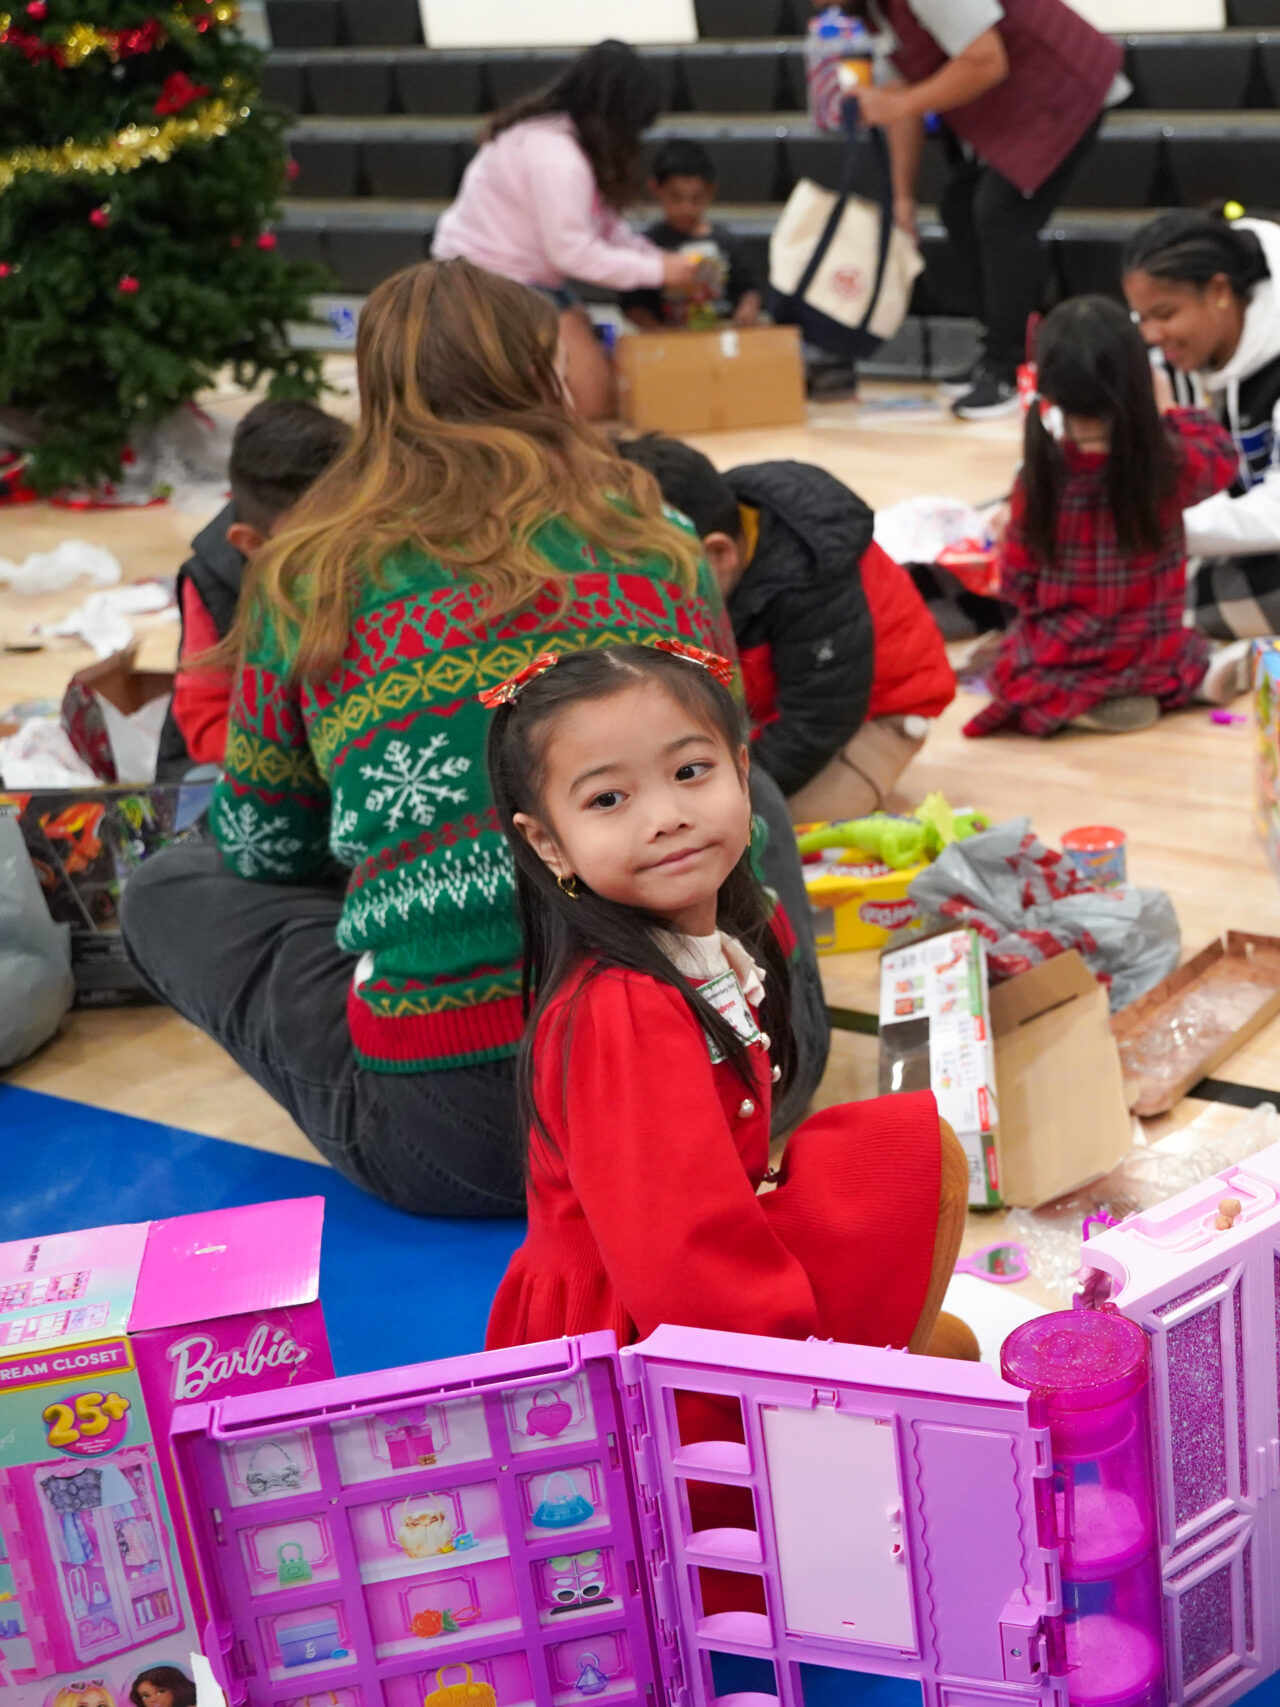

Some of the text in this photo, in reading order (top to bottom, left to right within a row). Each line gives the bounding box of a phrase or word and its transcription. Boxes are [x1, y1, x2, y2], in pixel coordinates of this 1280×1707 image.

[0, 1362, 49, 1381] REAM
[171, 1325, 308, 1400] Barbie
[43, 1391, 131, 1447] 25+
